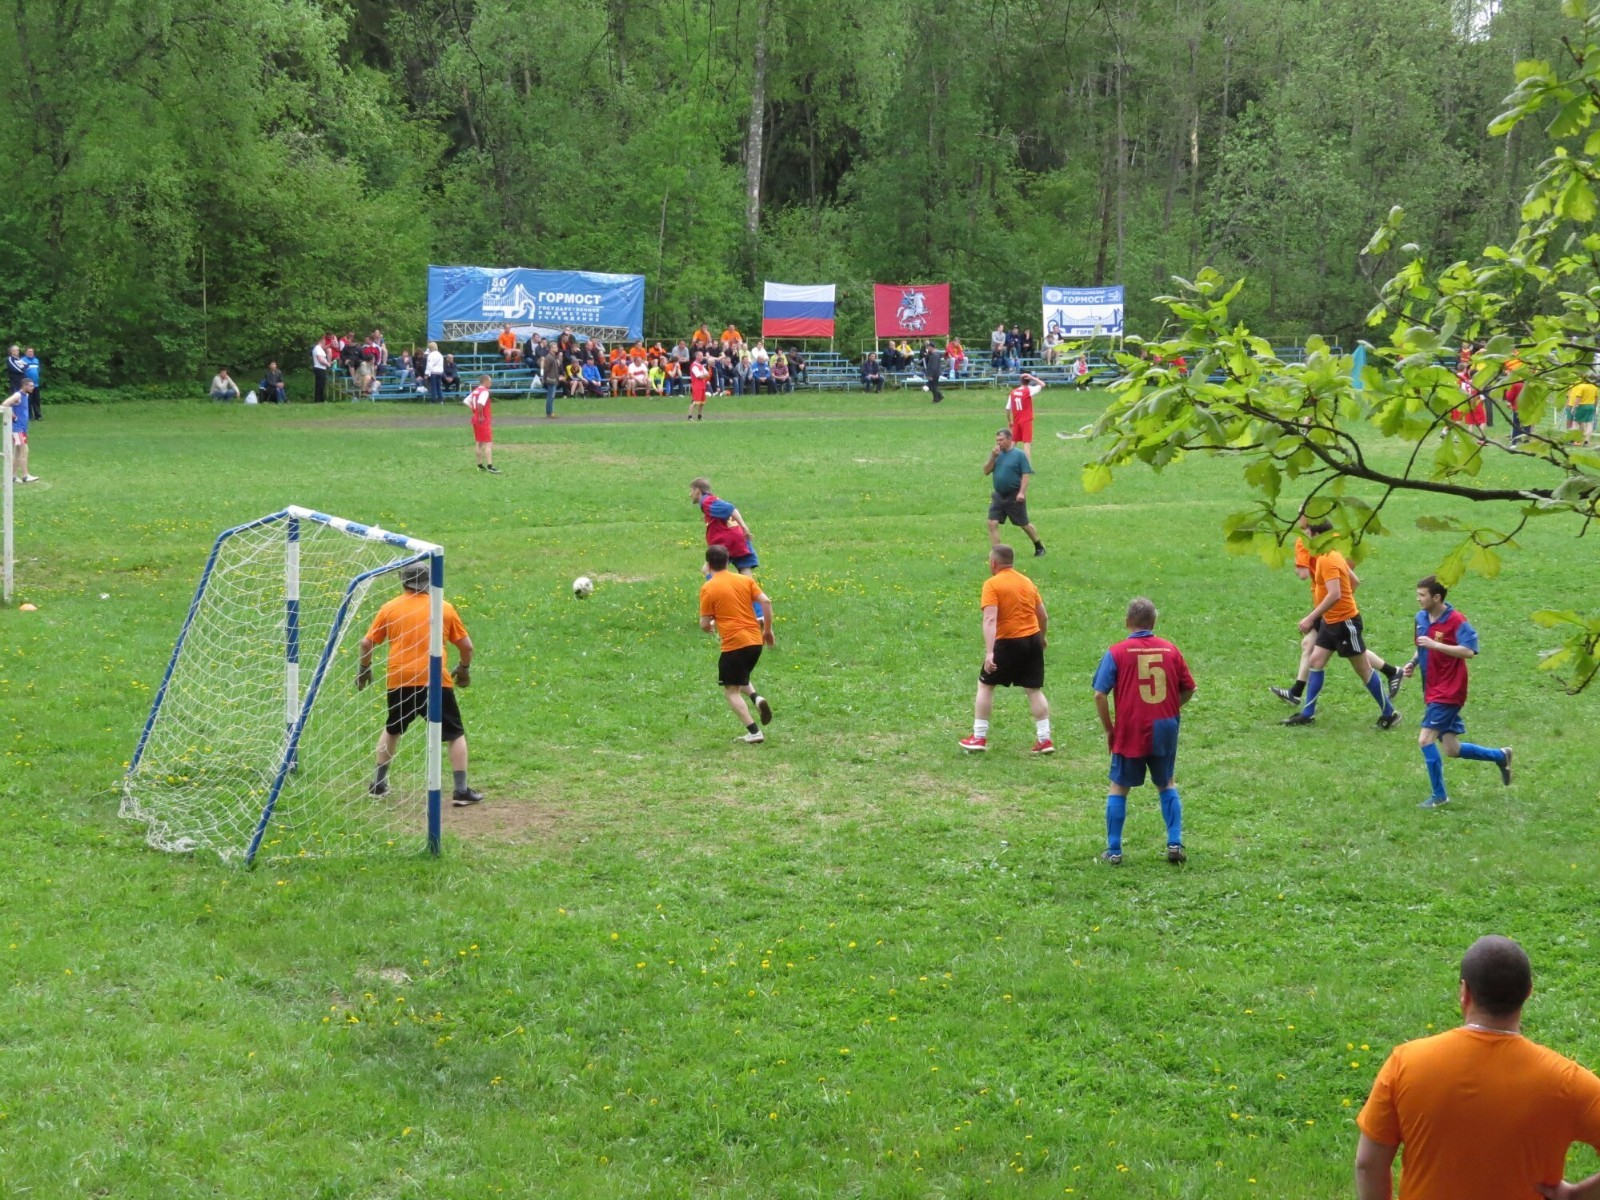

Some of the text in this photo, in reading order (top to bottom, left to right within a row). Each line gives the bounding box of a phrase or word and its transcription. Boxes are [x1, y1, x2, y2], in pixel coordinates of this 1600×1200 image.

[491, 277, 507, 287] 80
[538, 291, 602, 305] ГОРМОСТ
[1063, 295, 1106, 303] ГОРМОСТ
[1014, 396, 1023, 411] 11
[1137, 654, 1167, 704] 5
